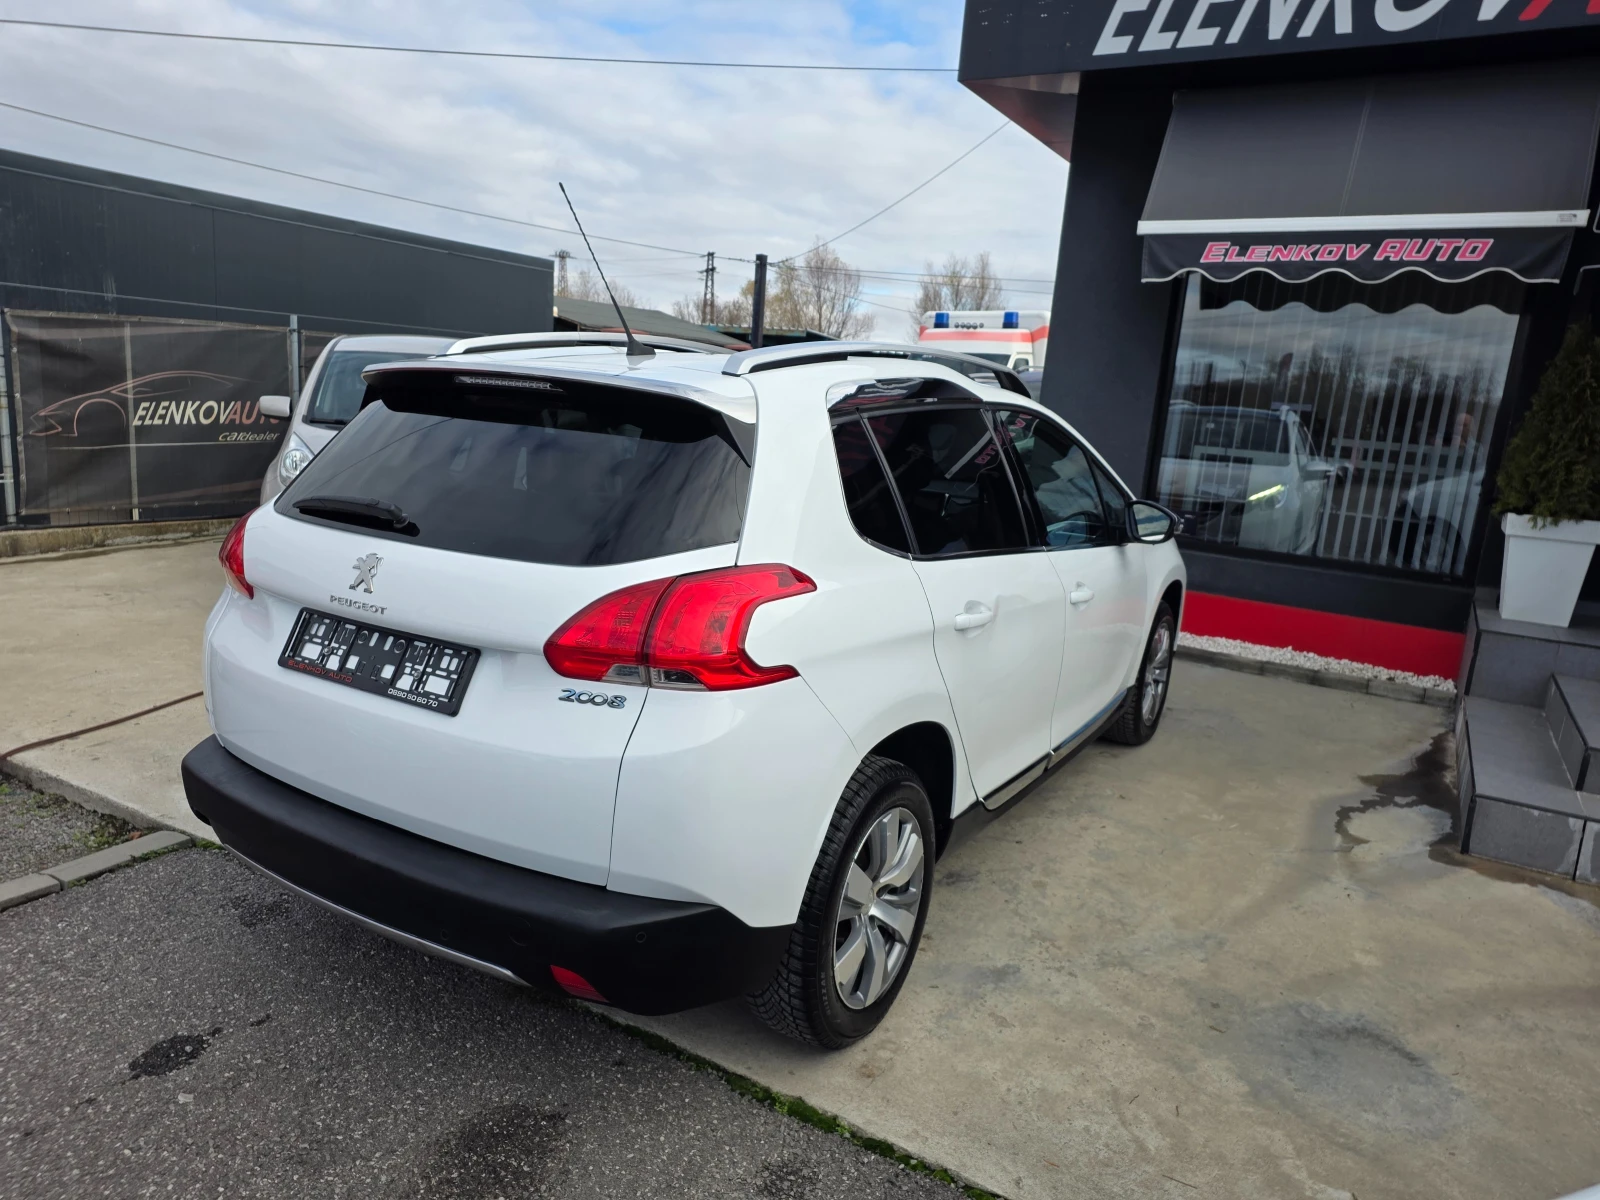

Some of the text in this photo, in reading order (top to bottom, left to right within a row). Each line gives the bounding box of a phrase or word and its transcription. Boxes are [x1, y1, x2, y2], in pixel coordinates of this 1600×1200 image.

[1200, 238, 1495, 262] ELENKOV AUTO
[329, 594, 388, 615] PEUGEOT
[328, 671, 353, 683] AUTO
[557, 687, 628, 710] 2008
